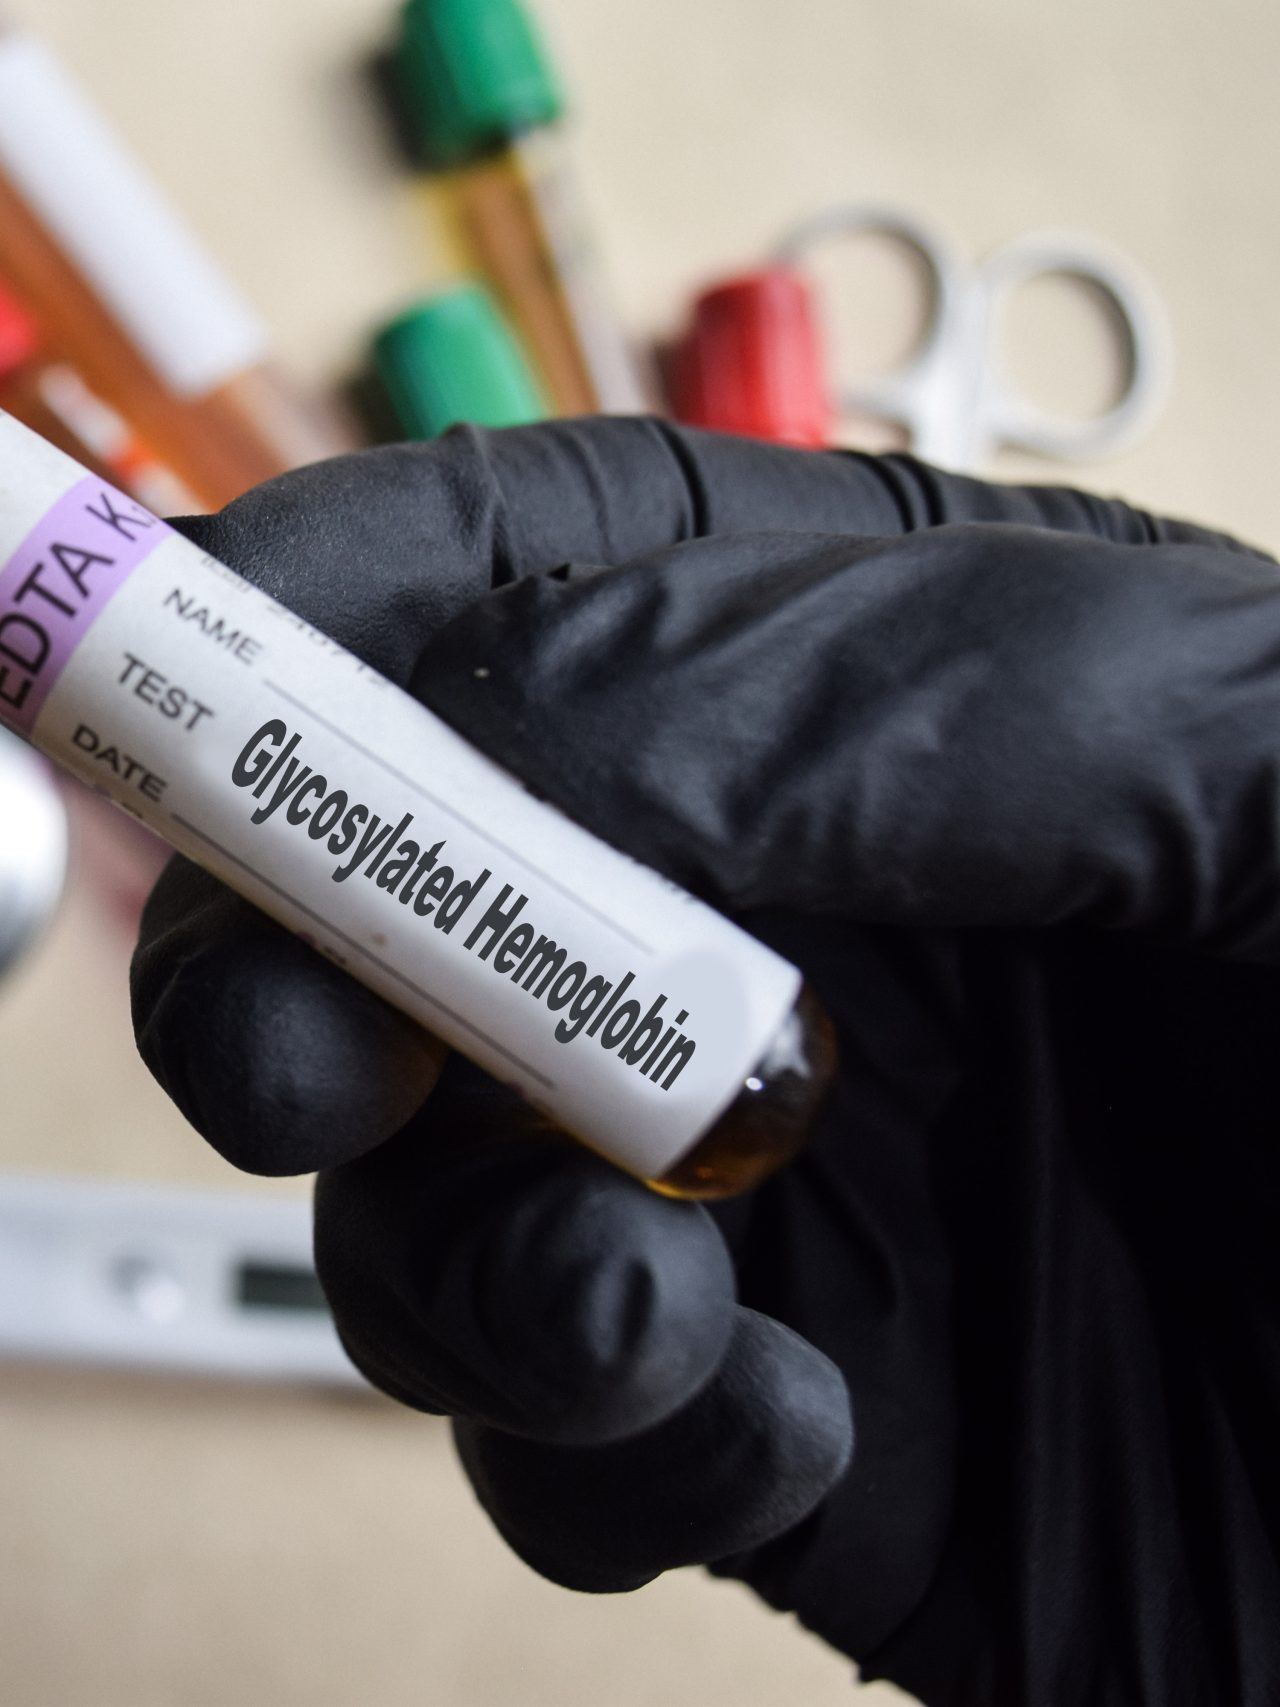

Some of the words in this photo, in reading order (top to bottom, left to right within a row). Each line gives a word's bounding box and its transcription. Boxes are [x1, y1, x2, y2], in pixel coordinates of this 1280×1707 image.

[164, 588, 263, 665] NAME
[118, 652, 214, 734] TEST
[71, 724, 167, 803] DATE
[231, 718, 492, 935] Glycosylated
[462, 883, 696, 1091] Hemoglobin
